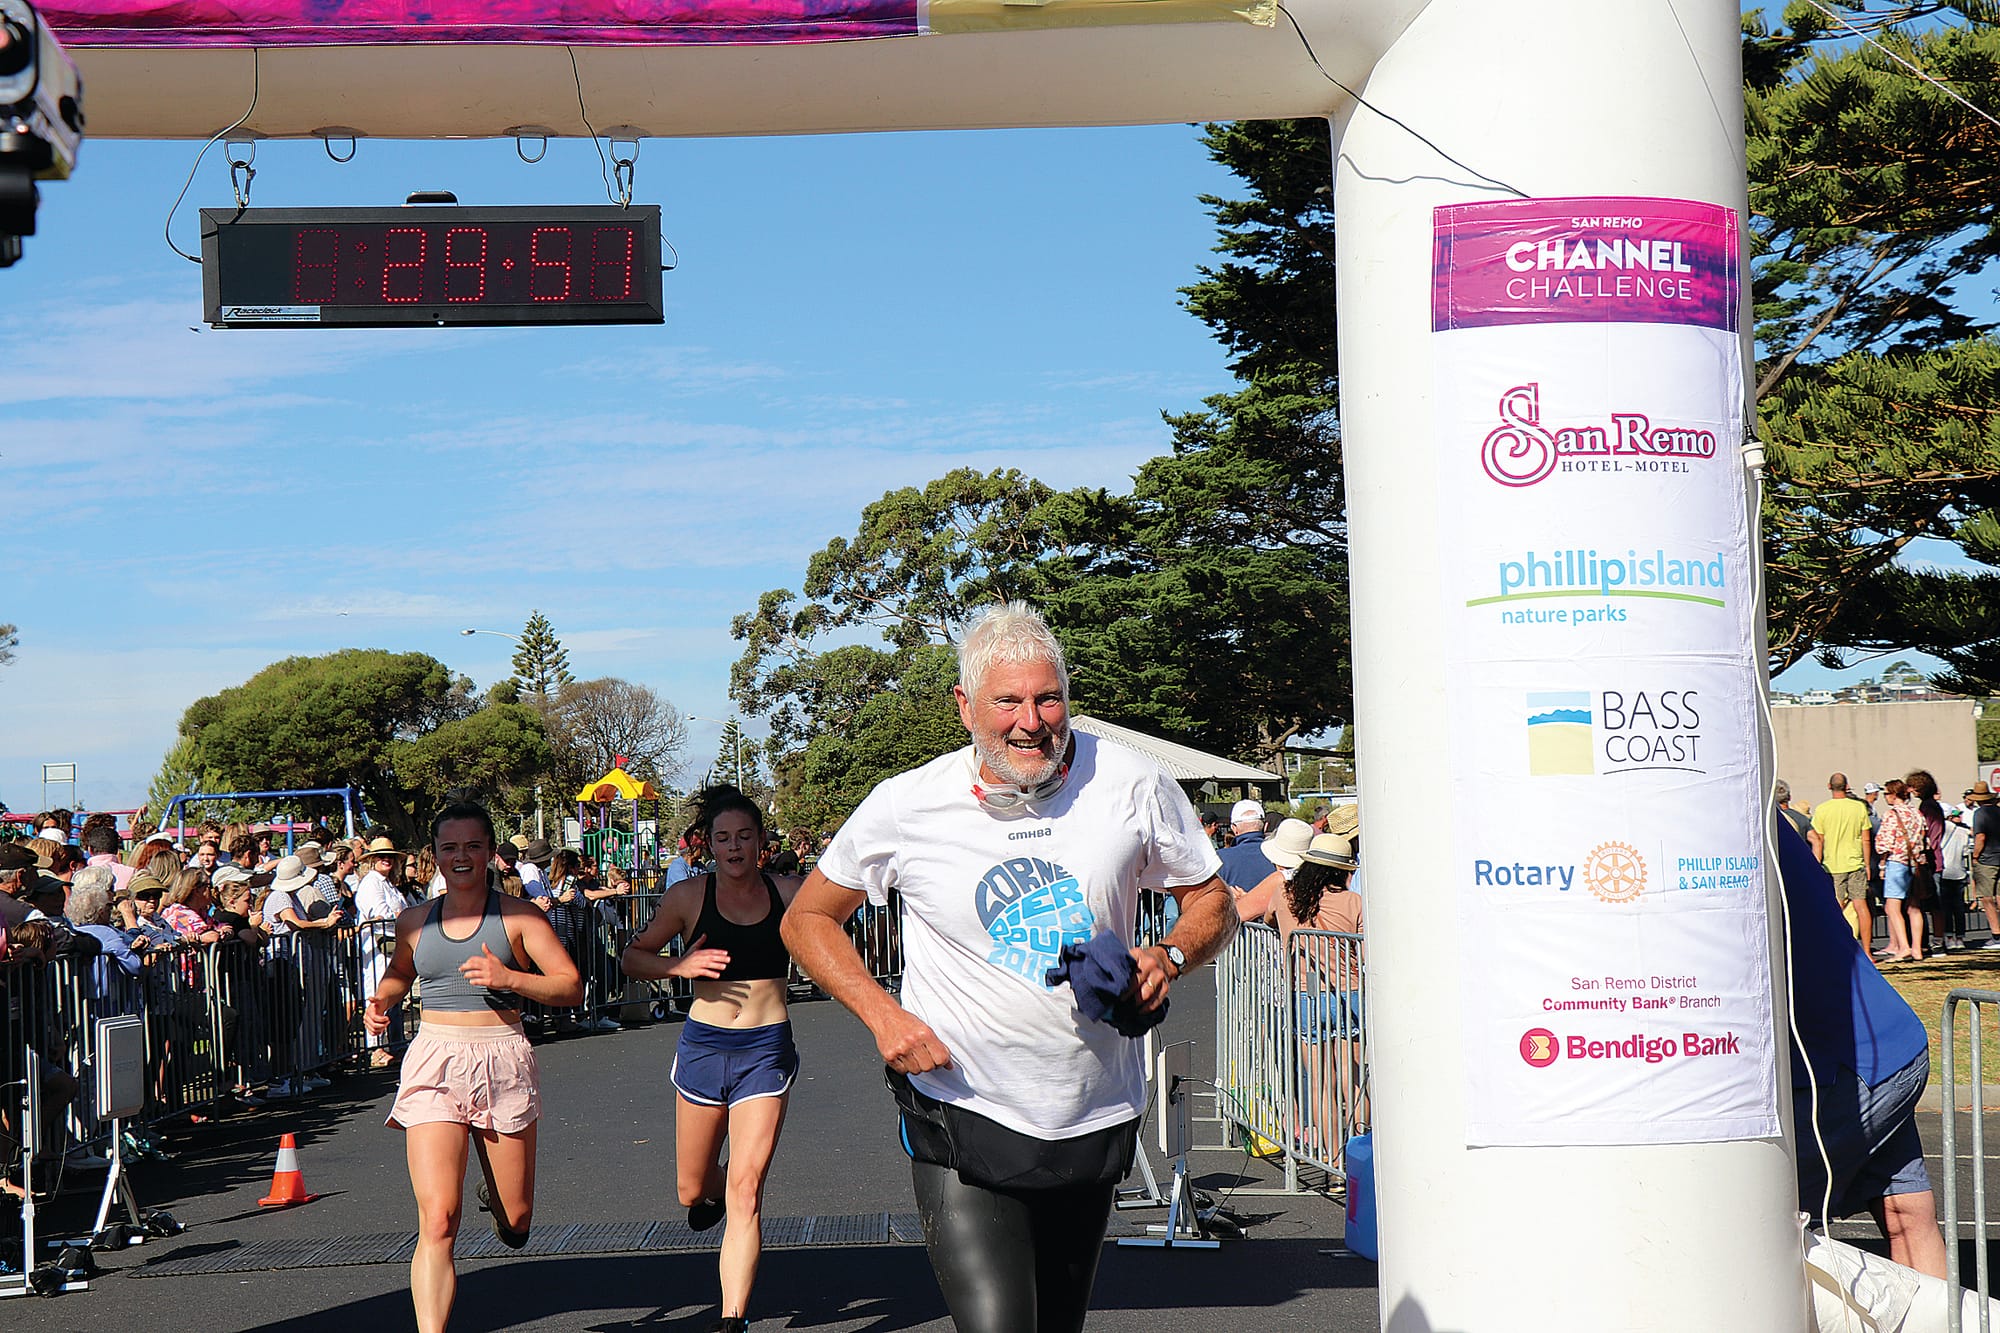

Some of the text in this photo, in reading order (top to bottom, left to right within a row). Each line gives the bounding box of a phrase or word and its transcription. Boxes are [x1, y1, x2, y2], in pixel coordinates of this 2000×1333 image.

[1571, 217, 1642, 228] SAN REMO
[1506, 239, 1691, 273] CHANNEL
[1505, 276, 1692, 300] CHALLENGE
[1481, 382, 1716, 488] San Remo
[1502, 604, 1628, 626] nature parks
[1602, 691, 1700, 730] BASS
[1605, 735, 1701, 763] COAST
[1474, 859, 1575, 891] Rotary
[1678, 856, 1759, 871] PHILLIP ISLAND
[1679, 875, 1749, 890] & SAN REMO
[1571, 976, 1697, 990] San Remo District
[1542, 997, 1627, 1012] Community
[1679, 995, 1721, 1008] Branch
[1566, 1034, 1677, 1063] Bendigo
[1682, 1031, 1740, 1057] Bank
